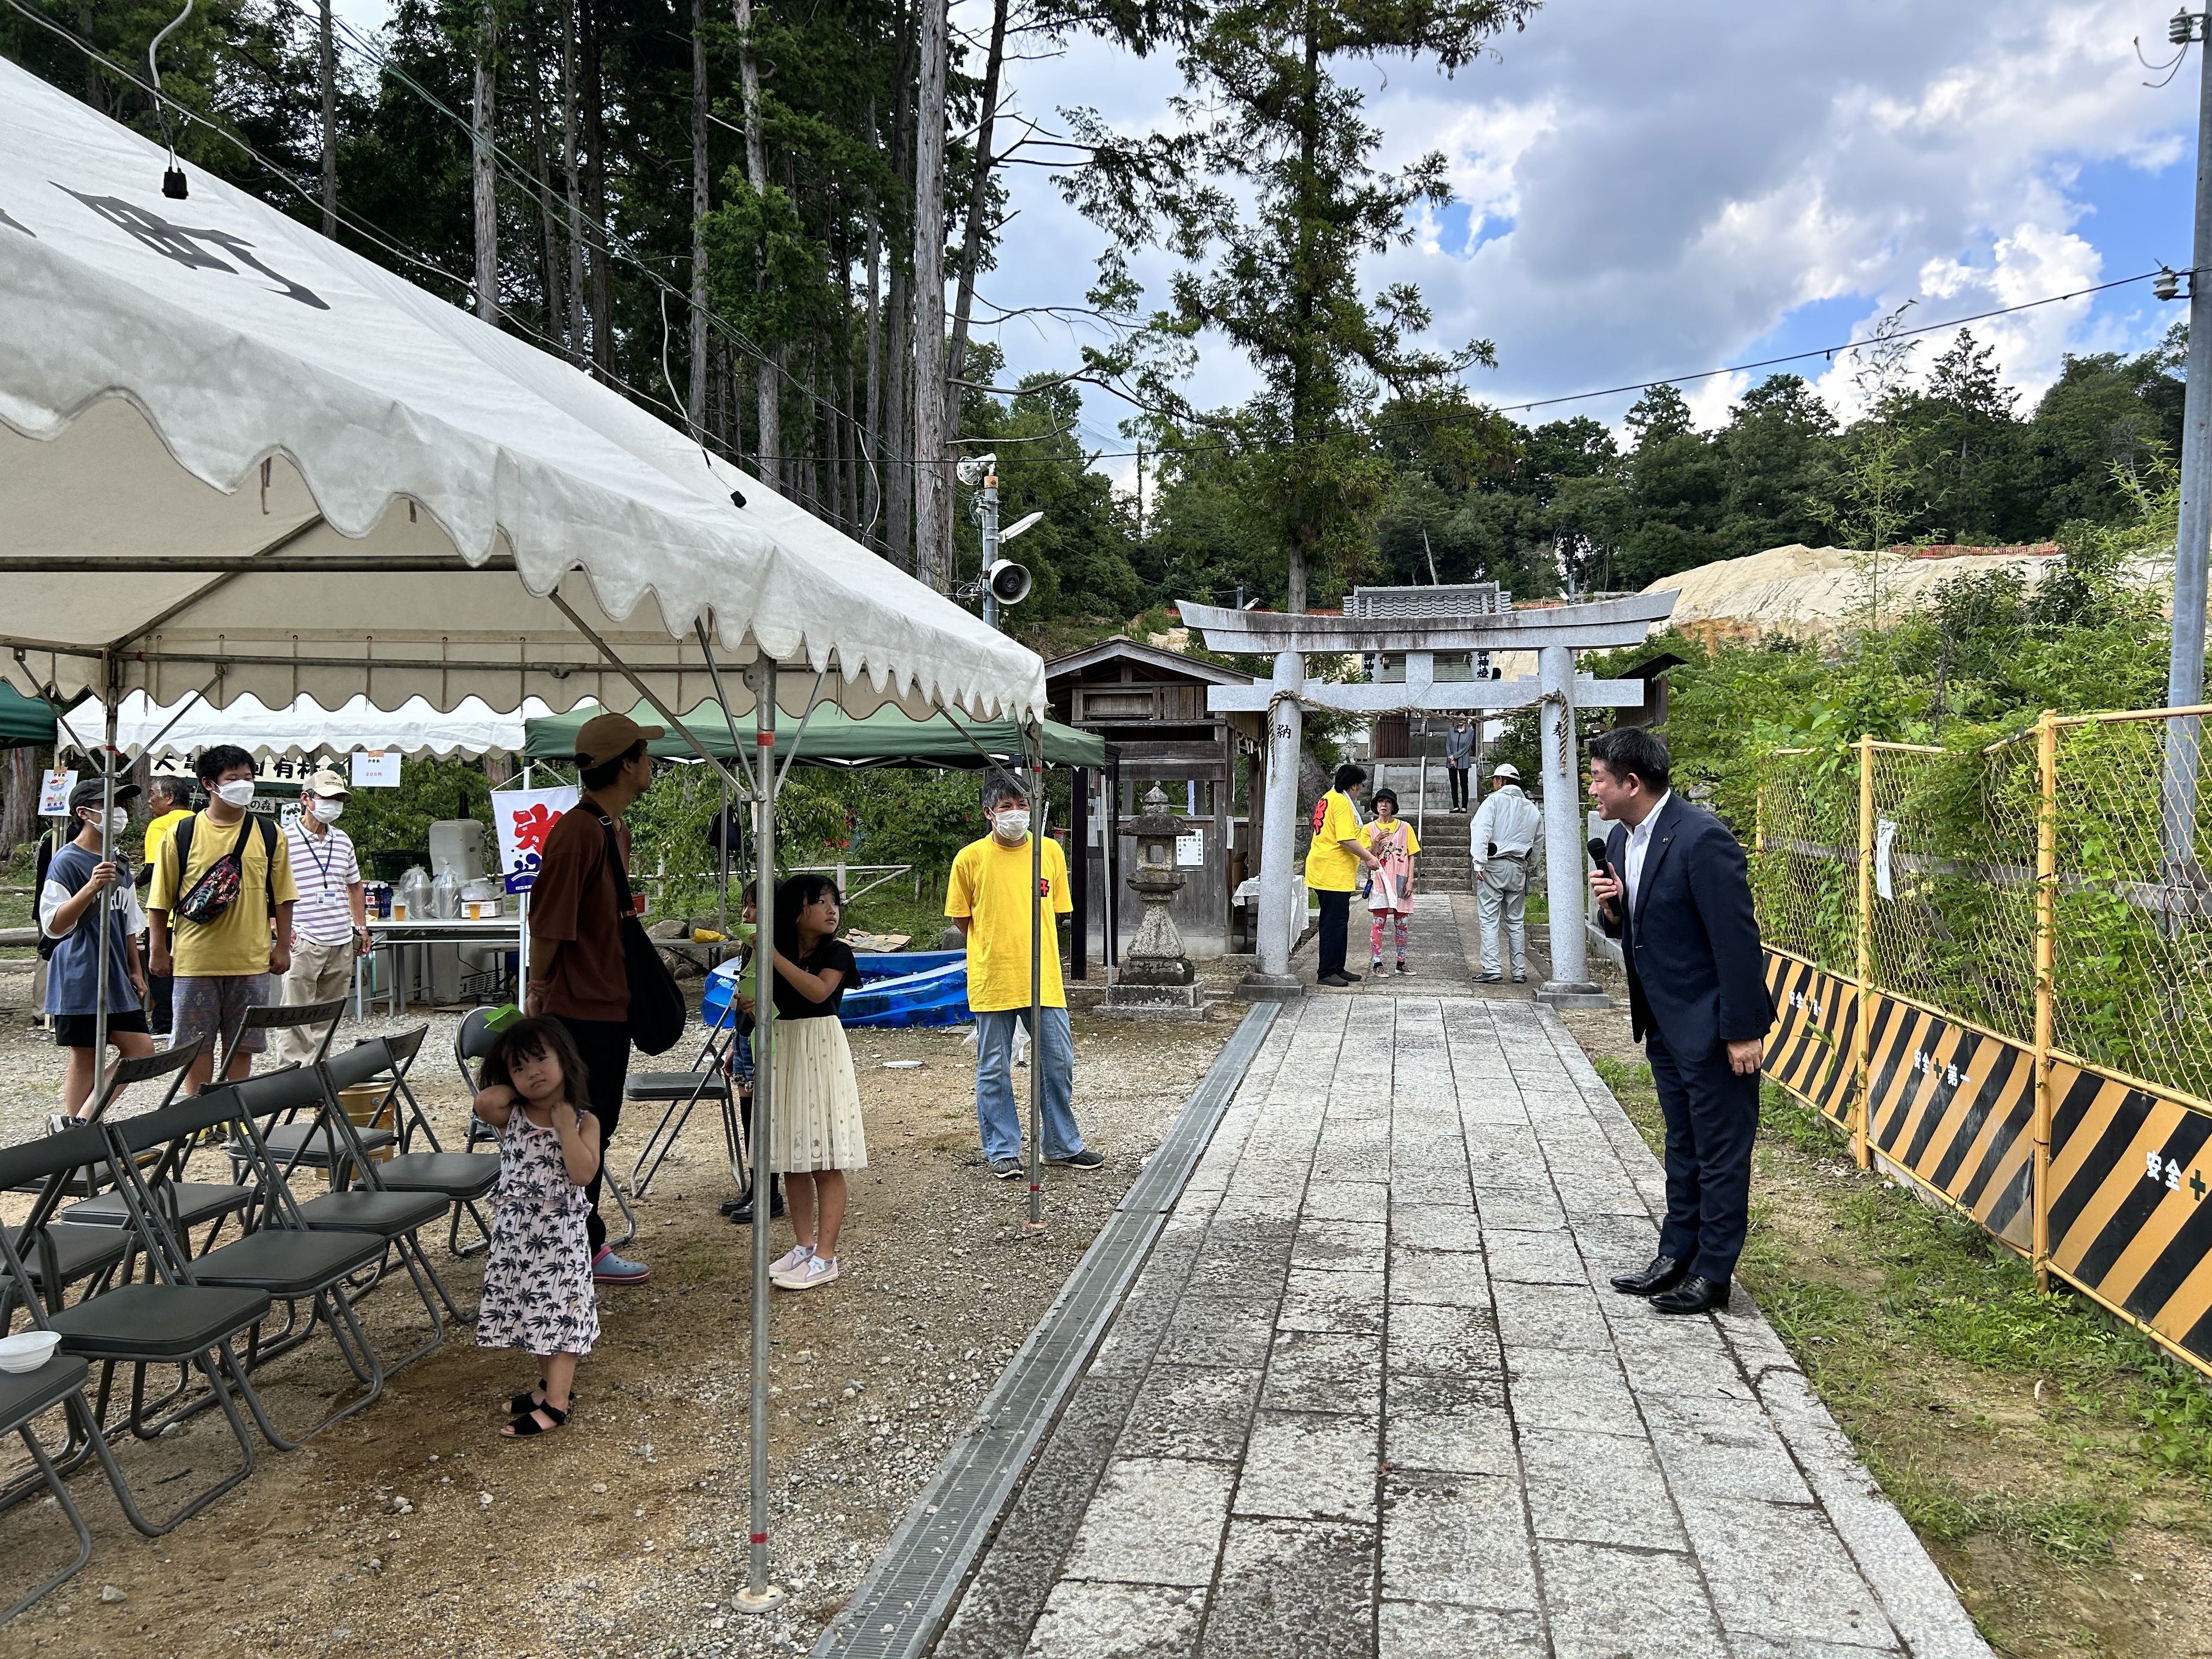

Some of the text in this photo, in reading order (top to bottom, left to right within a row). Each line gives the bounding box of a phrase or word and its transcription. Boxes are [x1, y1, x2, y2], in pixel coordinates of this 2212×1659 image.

[47, 180, 331, 309] 町
[1276, 724, 1291, 739] 納
[246, 799, 272, 811] の森
[1914, 1047, 1971, 1087] 安全 第一
[2146, 1149, 2181, 1192] 安全
